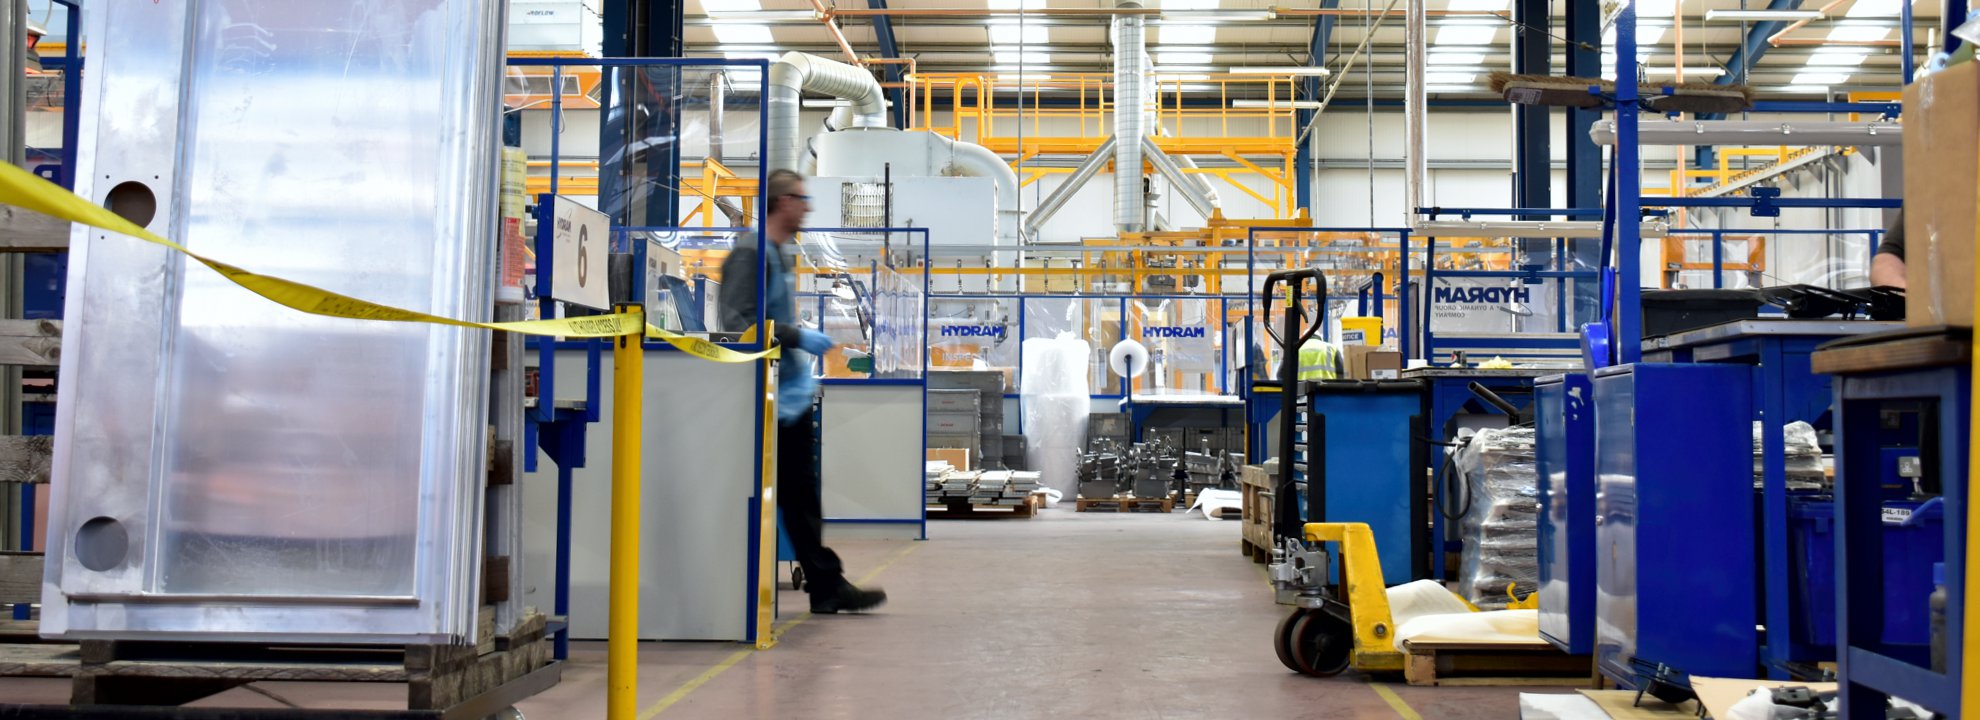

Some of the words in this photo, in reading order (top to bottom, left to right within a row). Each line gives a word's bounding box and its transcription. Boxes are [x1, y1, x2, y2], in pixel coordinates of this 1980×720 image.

[577, 223, 588, 289] 6
[941, 325, 1004, 337] HYDRAM
[1142, 326, 1205, 338] HYDRAM
